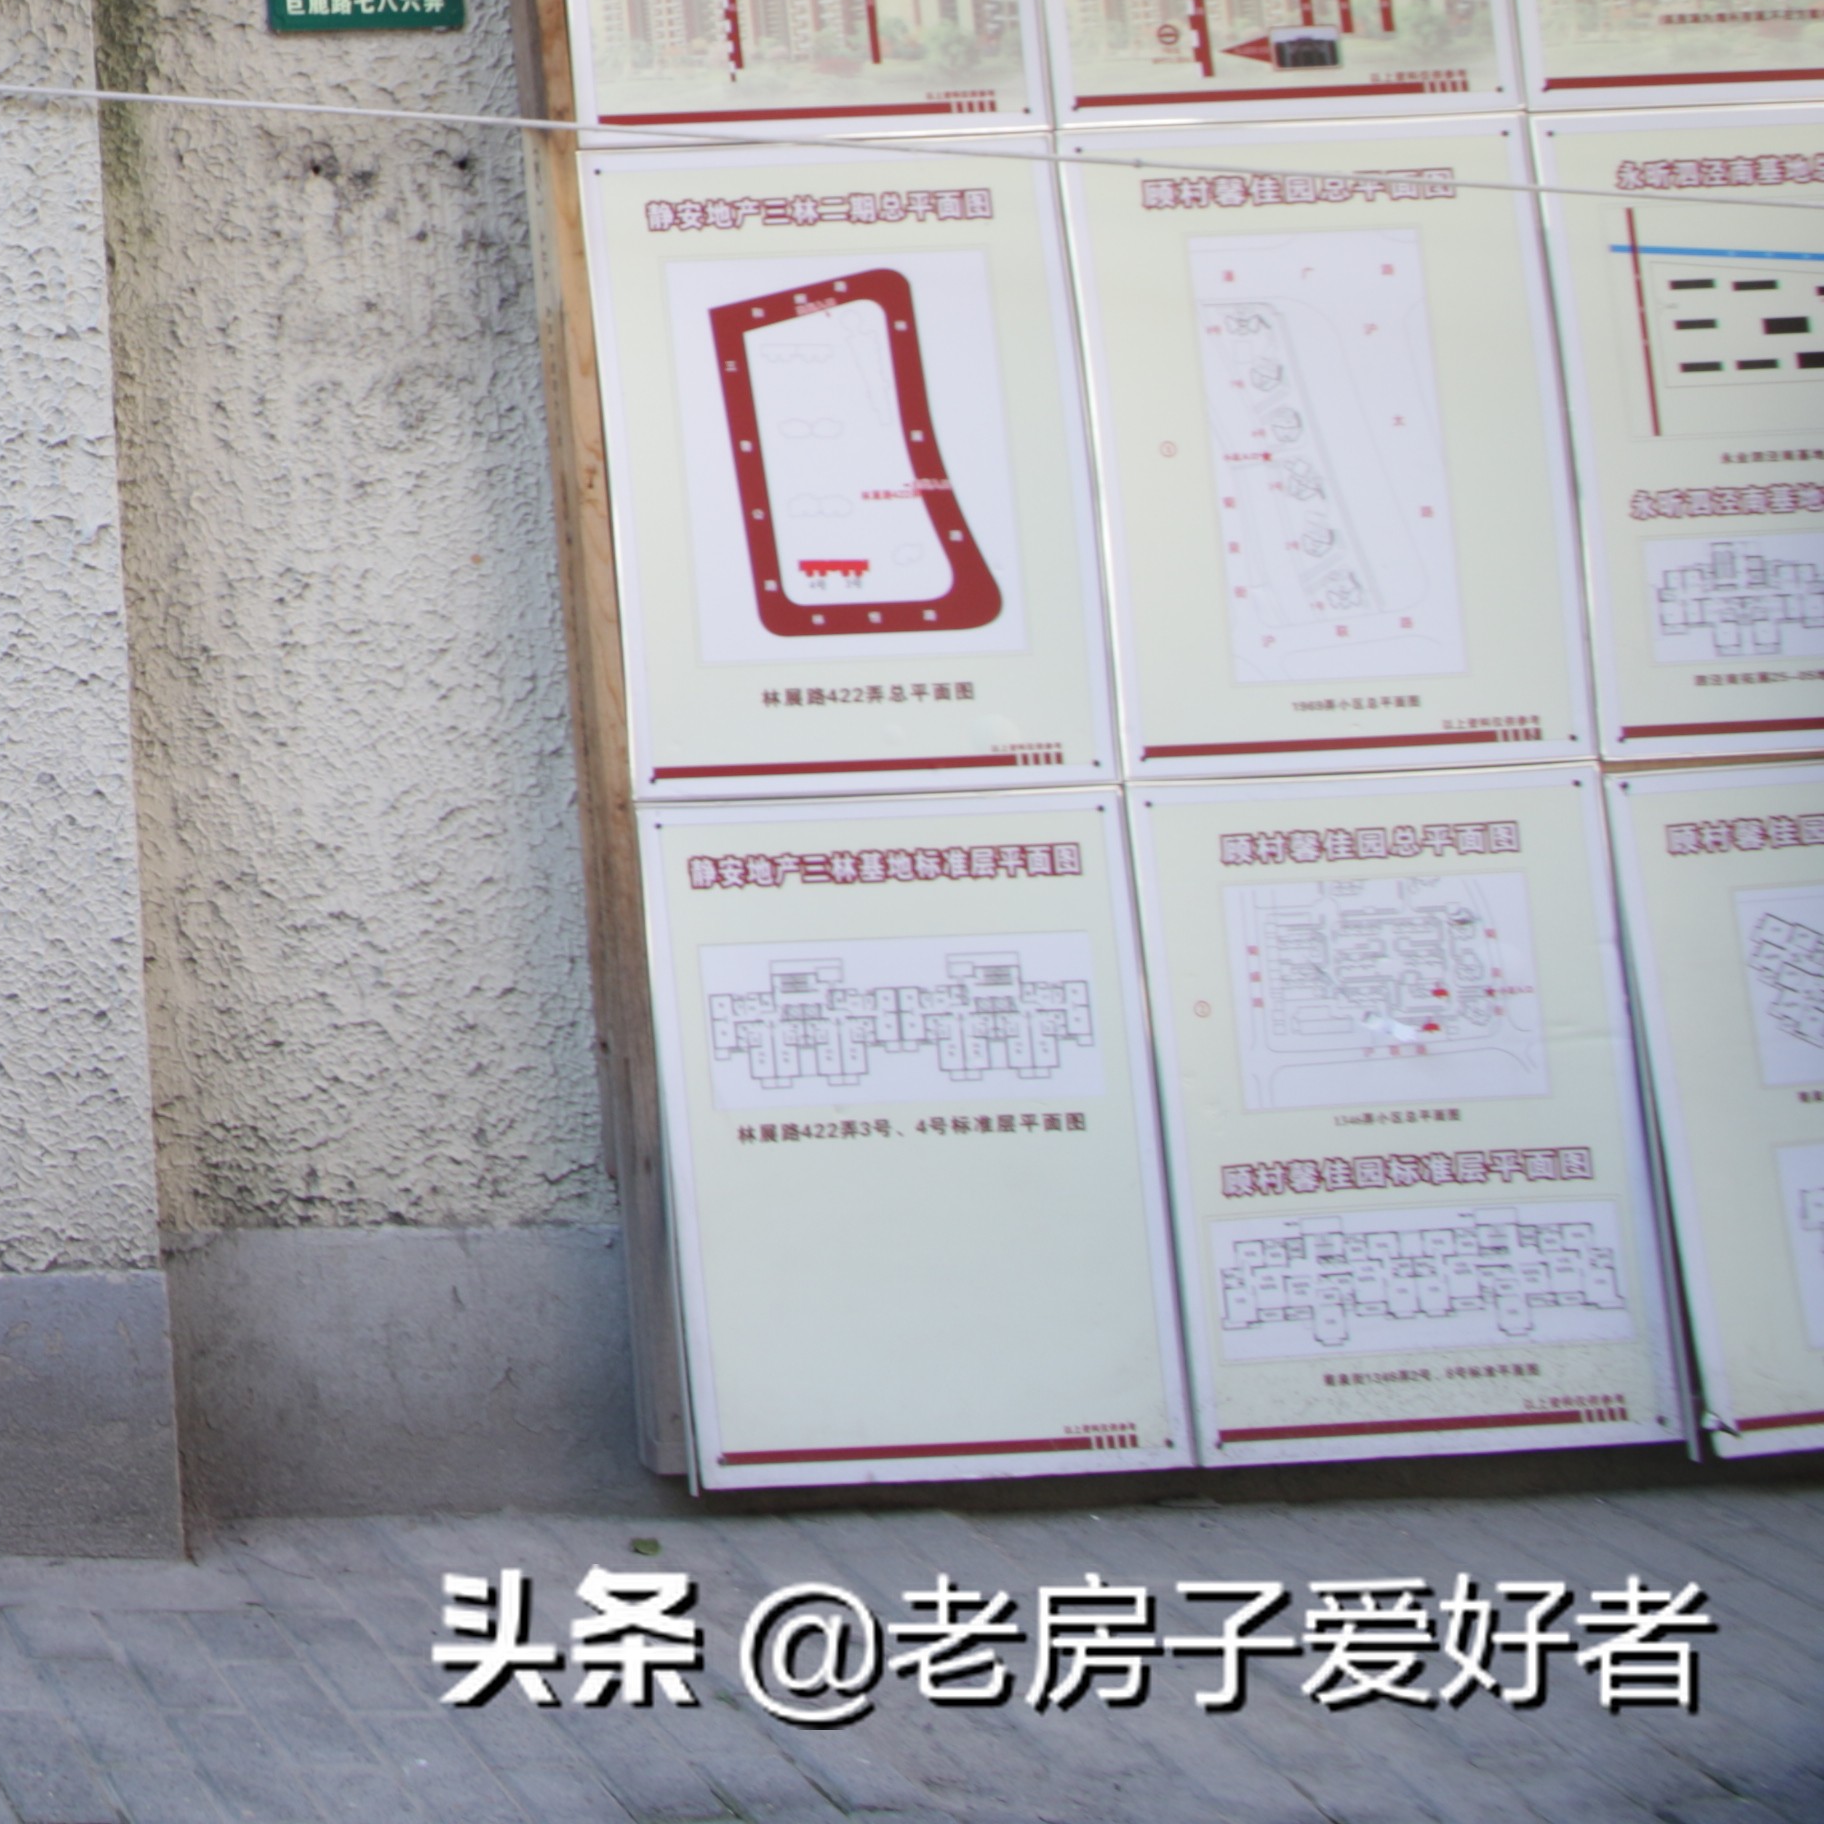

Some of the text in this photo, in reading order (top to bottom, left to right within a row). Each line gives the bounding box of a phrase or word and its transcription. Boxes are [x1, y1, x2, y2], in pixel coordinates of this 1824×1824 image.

[645, 188, 993, 232] 静安地产三林二期总平面图
[1142, 168, 1456, 209] 顾村馨佳园总平面图
[761, 682, 974, 707] 林展路422弄总平面图
[1219, 820, 1521, 866] 顾村馨佳园总平面图
[689, 842, 1082, 890] 静安地产三林基地标准层平面图
[736, 1111, 1088, 1144] 林展路422弄3号、4号标准层平面图
[1220, 1146, 1594, 1198] 顾村馨佳园标准层平面图
